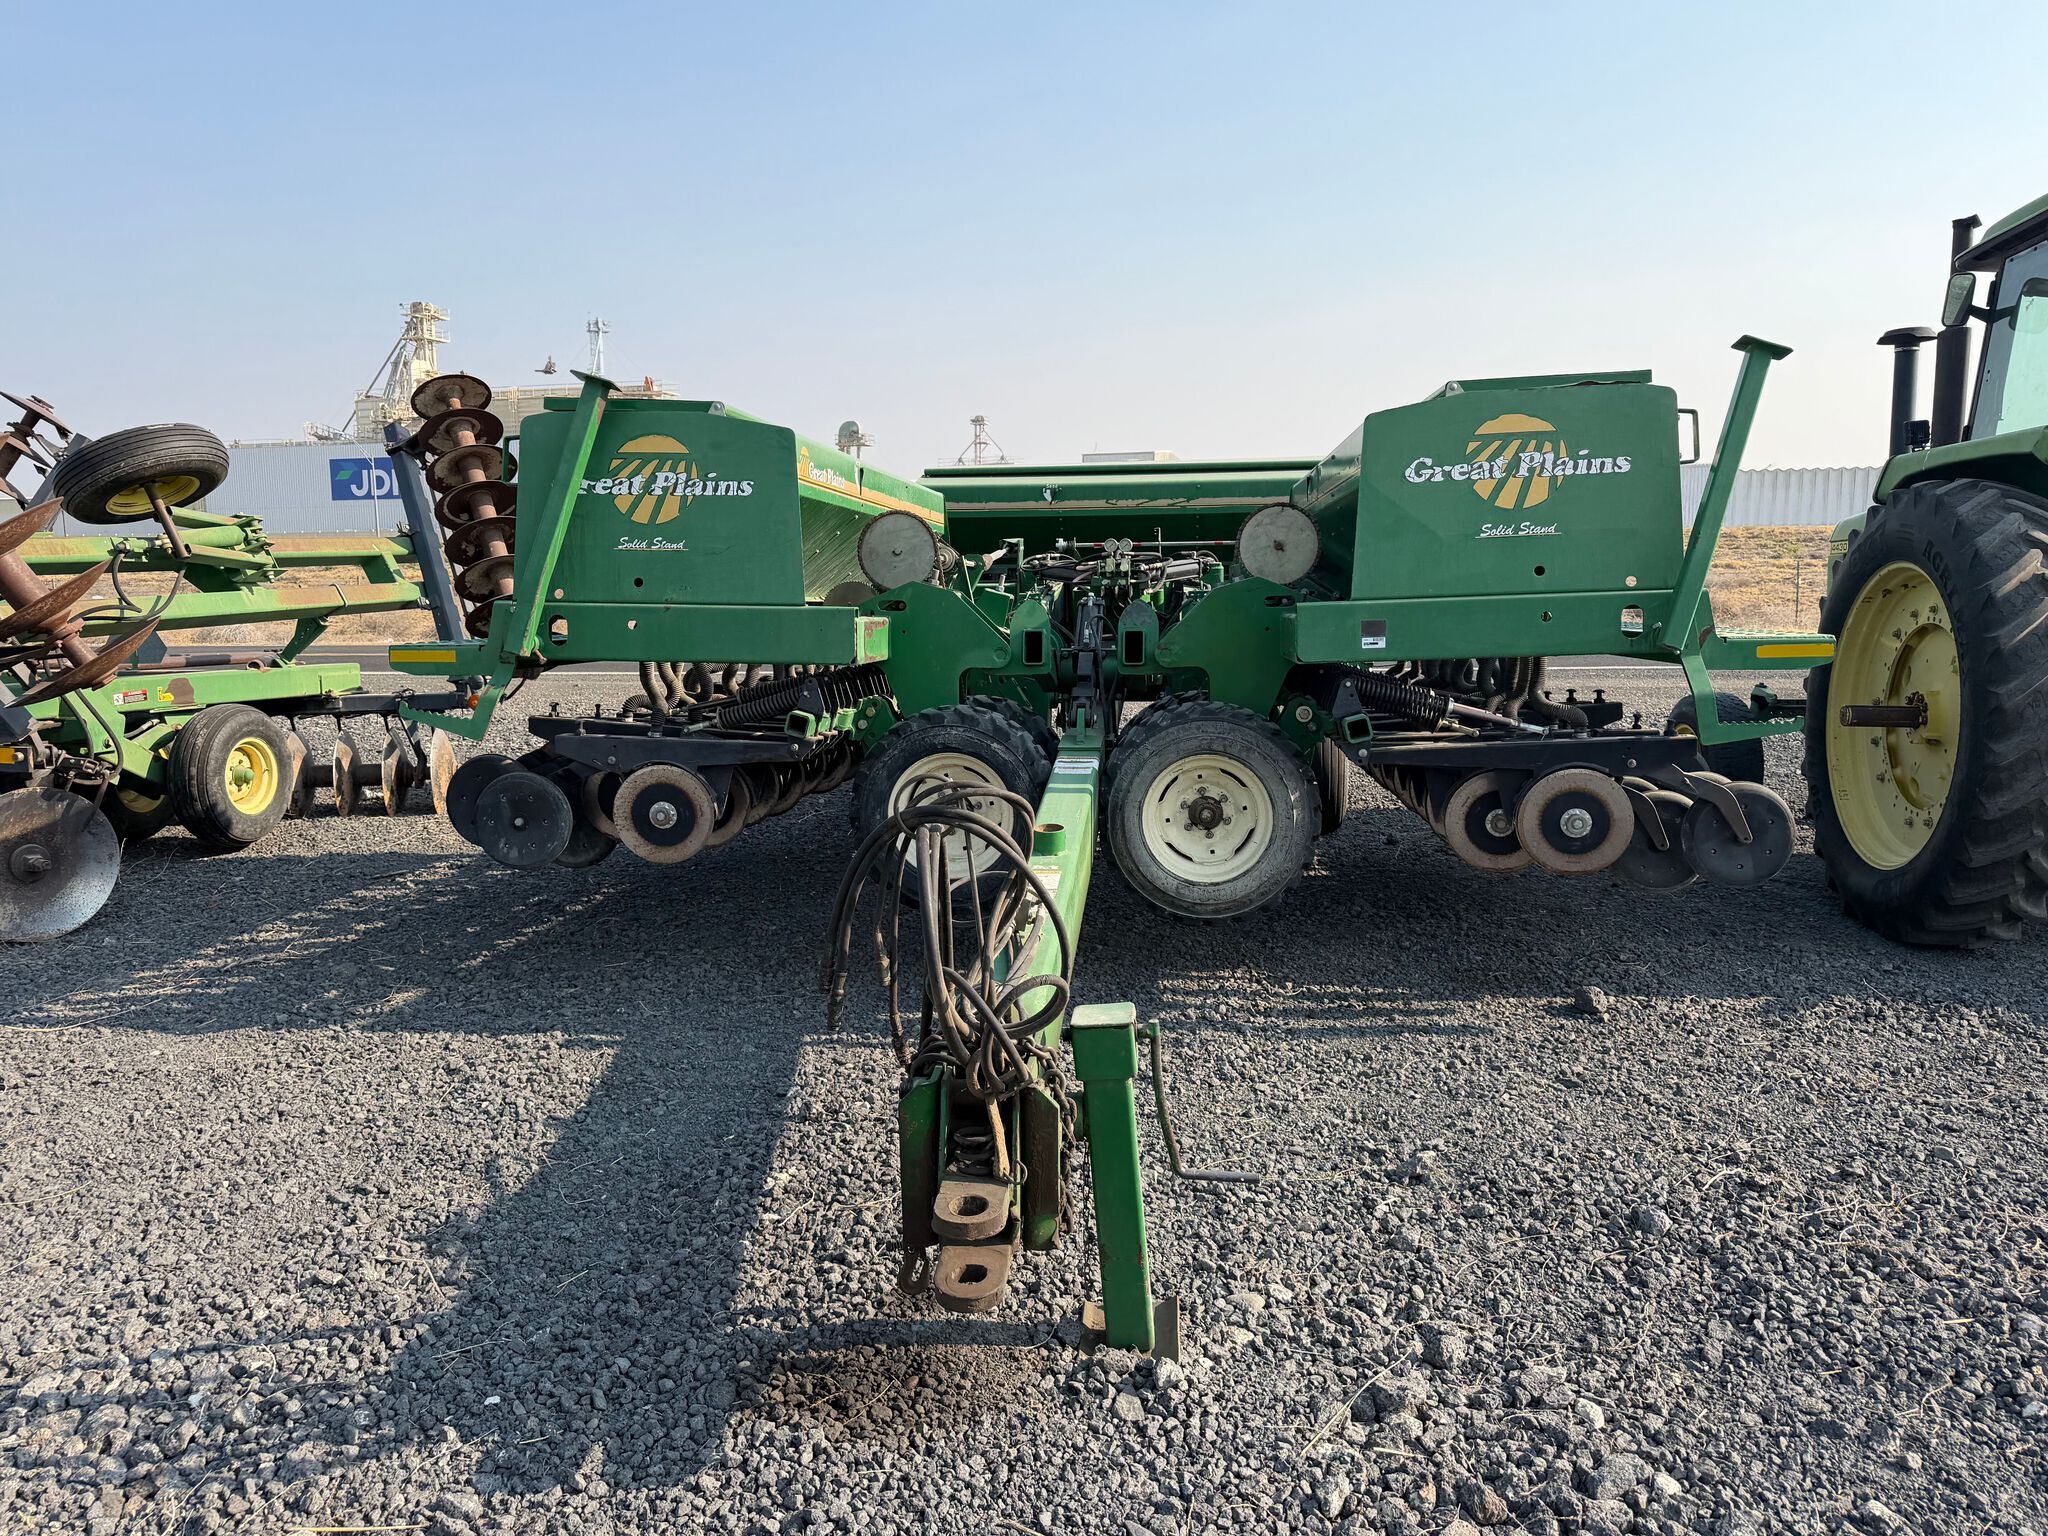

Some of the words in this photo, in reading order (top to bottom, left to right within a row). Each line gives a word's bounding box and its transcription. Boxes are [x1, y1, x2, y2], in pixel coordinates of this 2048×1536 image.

[1404, 455, 1508, 483] Great
[1514, 449, 1632, 478] Plains
[577, 473, 646, 496] reat
[651, 471, 755, 496] Plains
[1480, 523, 1514, 537] Solid
[1518, 522, 1557, 535] Stand
[617, 536, 648, 549] Solid
[651, 536, 686, 549] Stand
